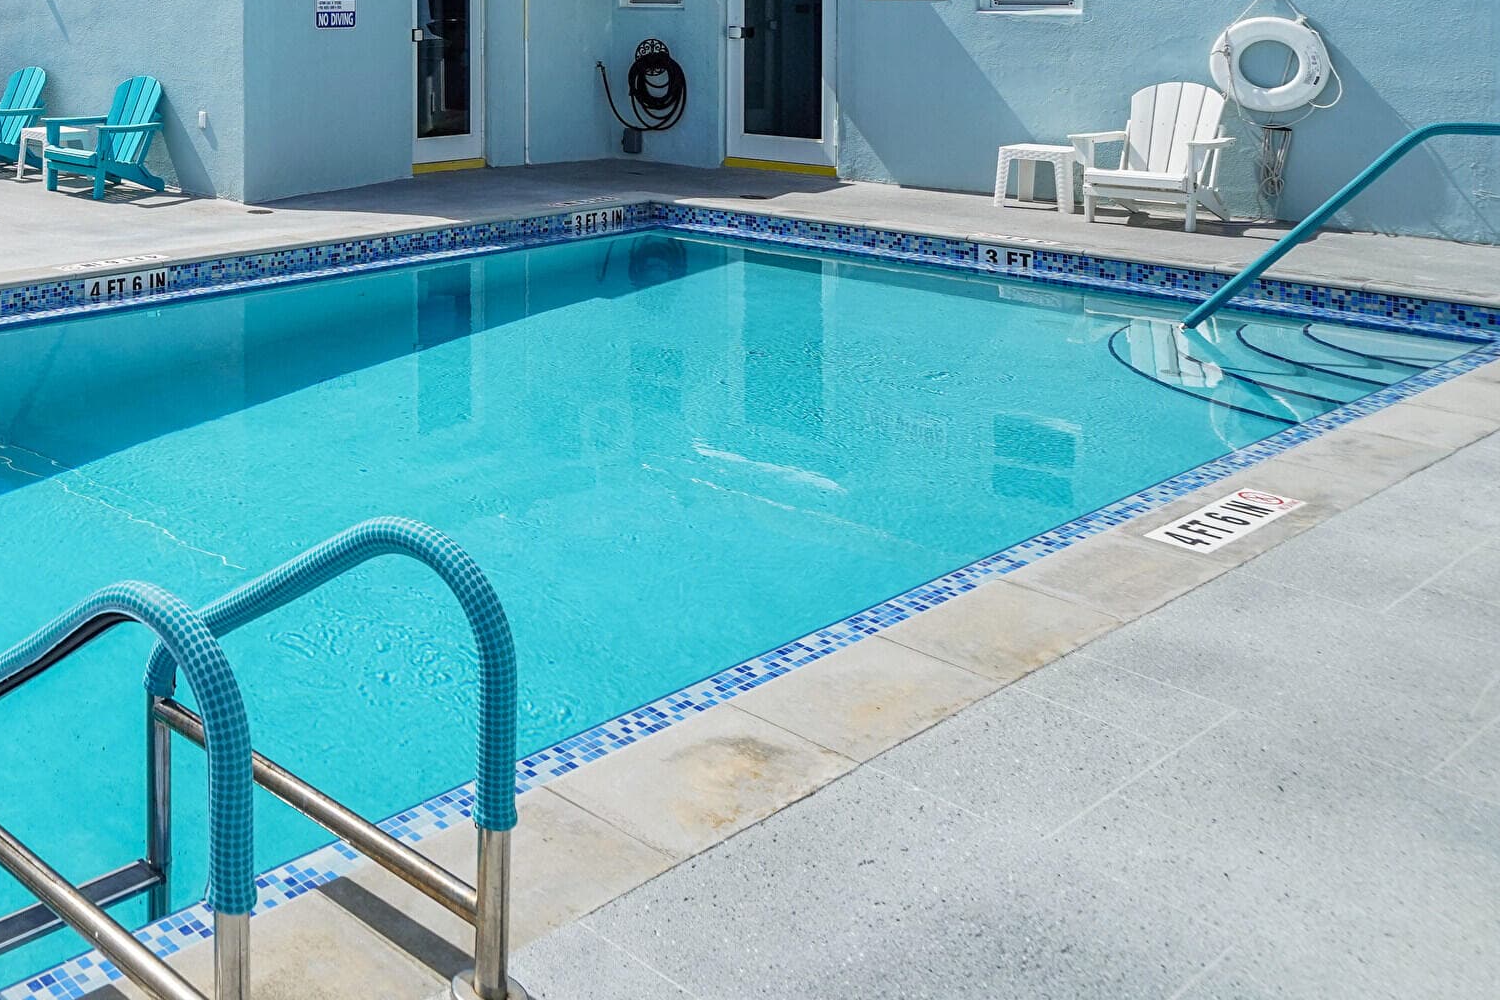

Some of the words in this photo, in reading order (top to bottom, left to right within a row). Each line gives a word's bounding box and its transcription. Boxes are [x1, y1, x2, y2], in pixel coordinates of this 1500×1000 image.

[318, 13, 328, 26] NO
[330, 12, 354, 26] DIVING
[985, 249, 998, 264] 3
[1007, 251, 1031, 268] FT
[90, 281, 100, 297] 4
[107, 277, 126, 295] FT
[132, 275, 142, 291] 6
[150, 271, 166, 288] IN
[1219, 499, 1275, 518] IN
[1204, 512, 1251, 526] 6
[1164, 531, 1211, 546] 4
[1177, 519, 1234, 540] FT
